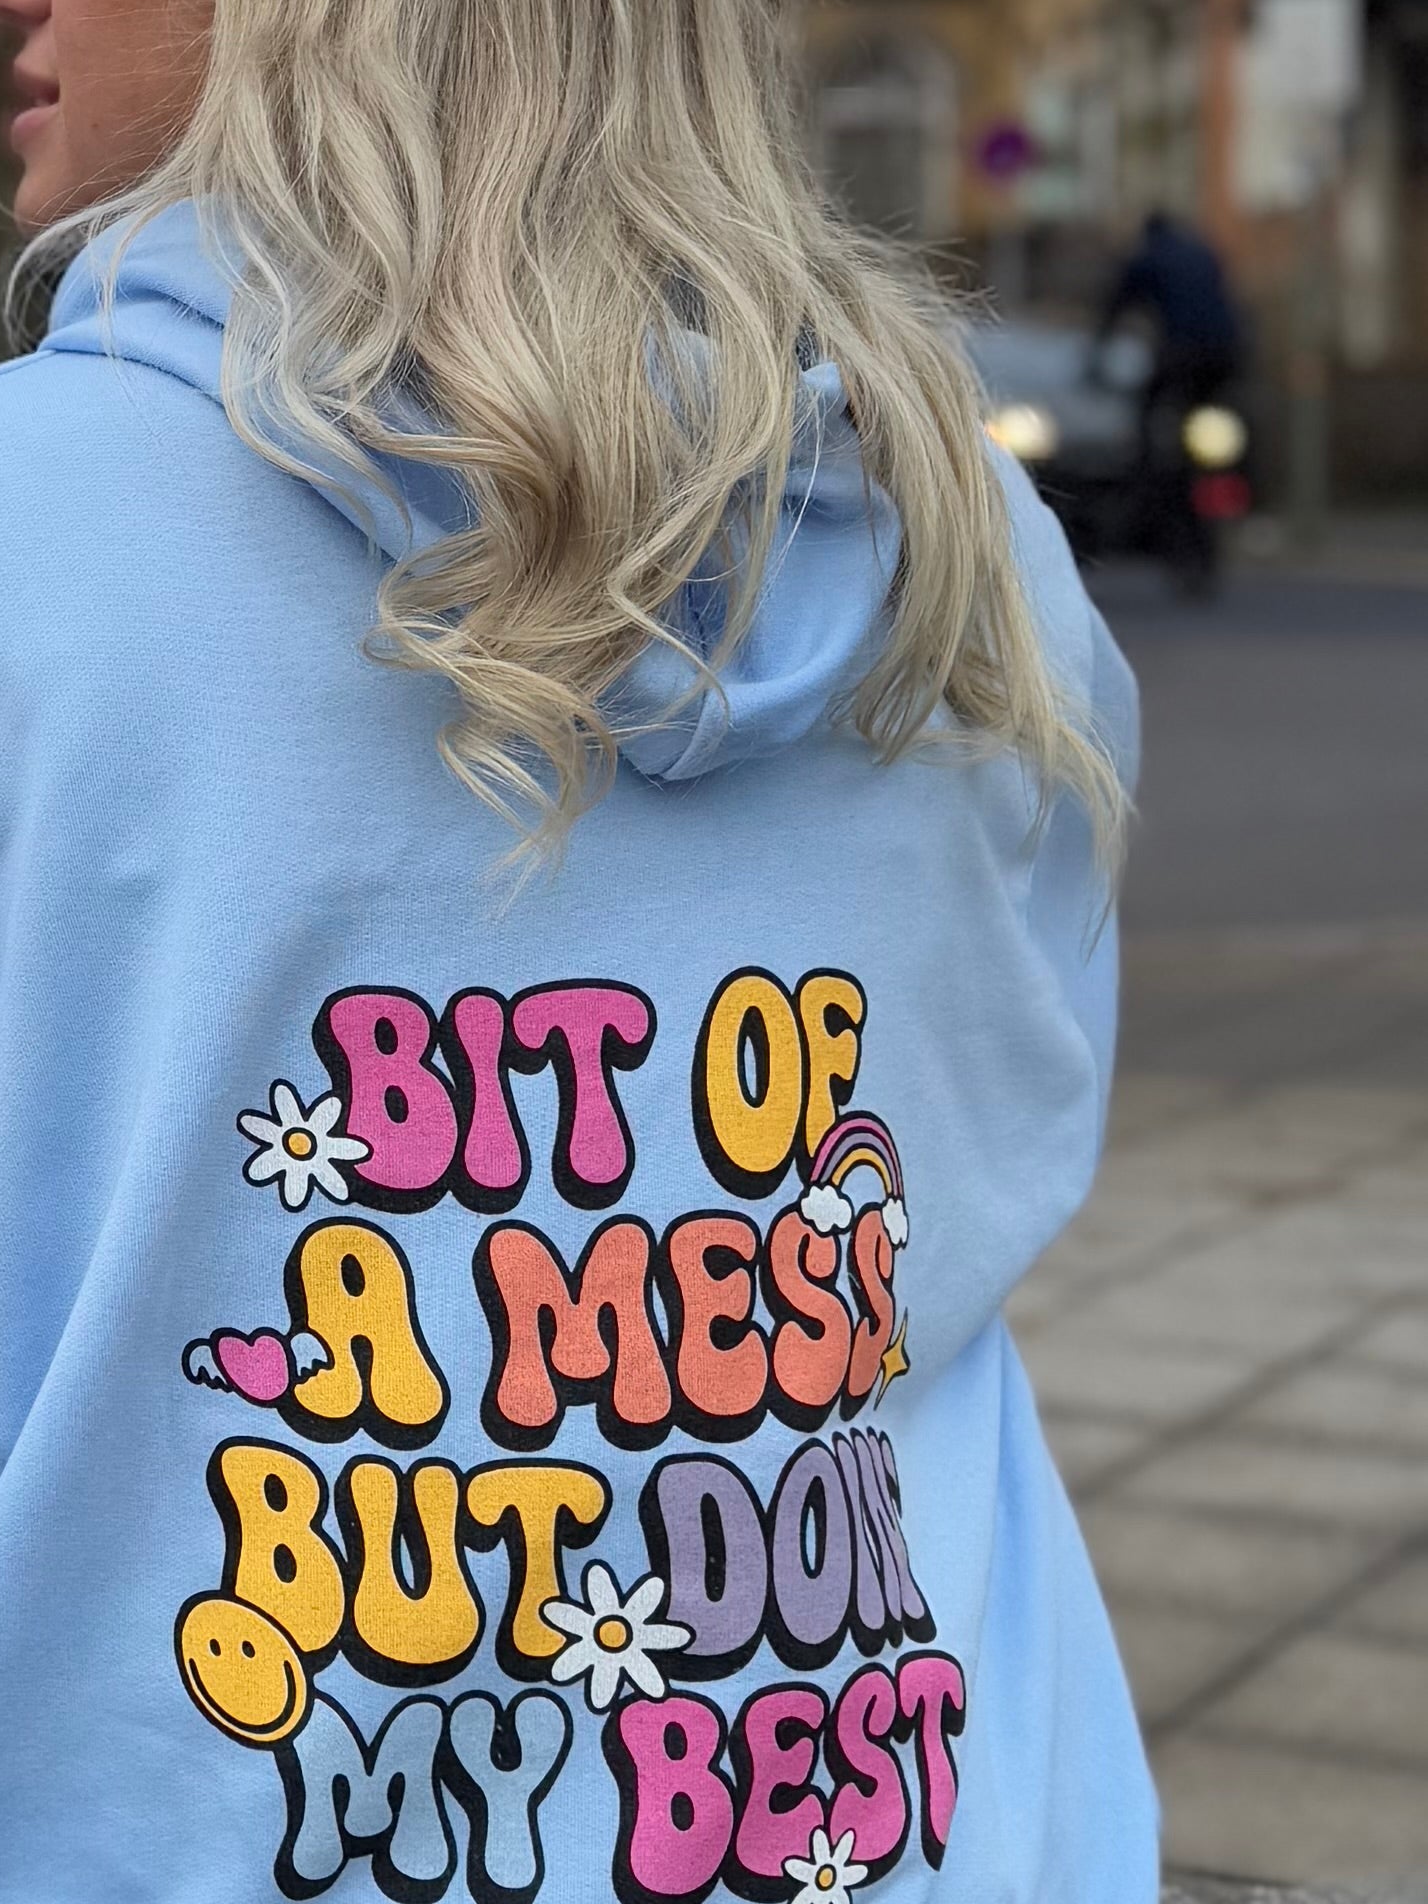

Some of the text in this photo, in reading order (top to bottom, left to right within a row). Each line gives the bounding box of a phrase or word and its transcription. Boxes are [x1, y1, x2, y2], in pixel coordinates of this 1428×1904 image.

[311, 966, 866, 1213] BIT OF
[282, 1209, 902, 1449] A MESS
[206, 1434, 614, 1688] BUT
